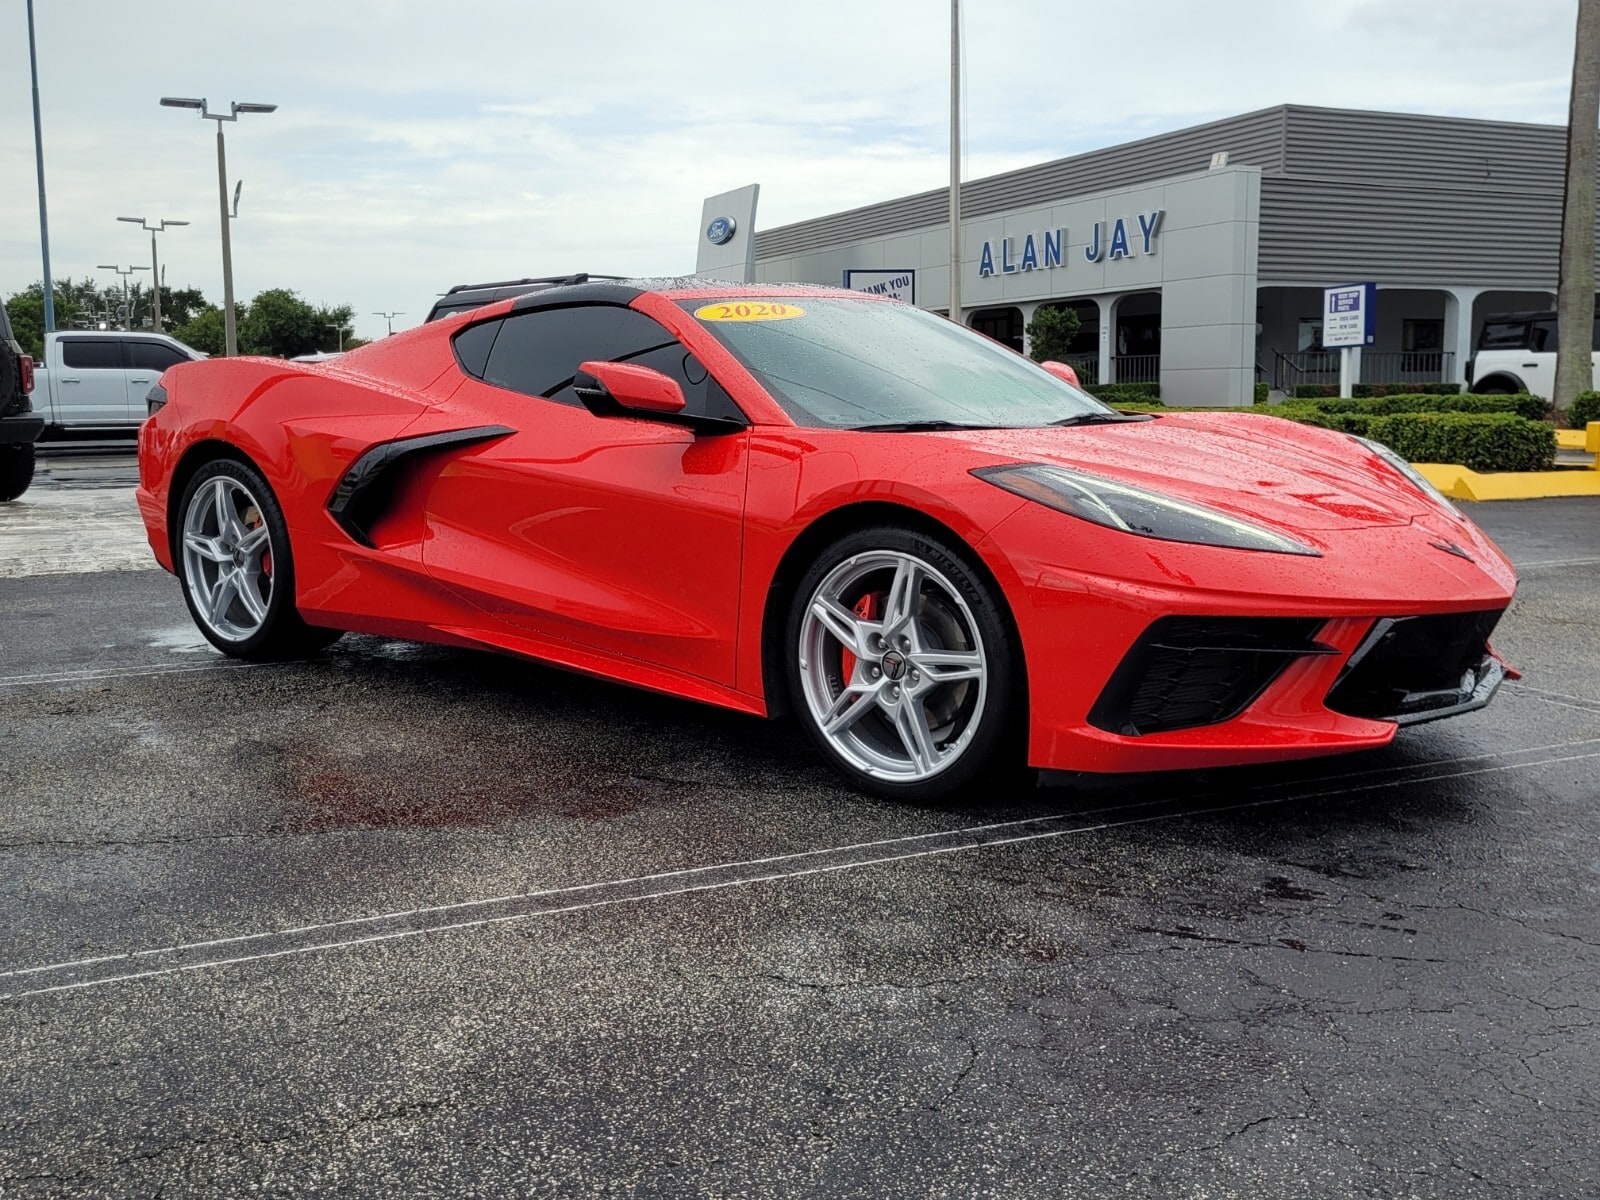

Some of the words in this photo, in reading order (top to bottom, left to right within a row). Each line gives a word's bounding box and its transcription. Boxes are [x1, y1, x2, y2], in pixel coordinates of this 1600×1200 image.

[978, 226, 1066, 278] ALAN
[1084, 210, 1164, 263] JAY
[888, 275, 909, 290] YOU
[716, 304, 787, 319] 2020
